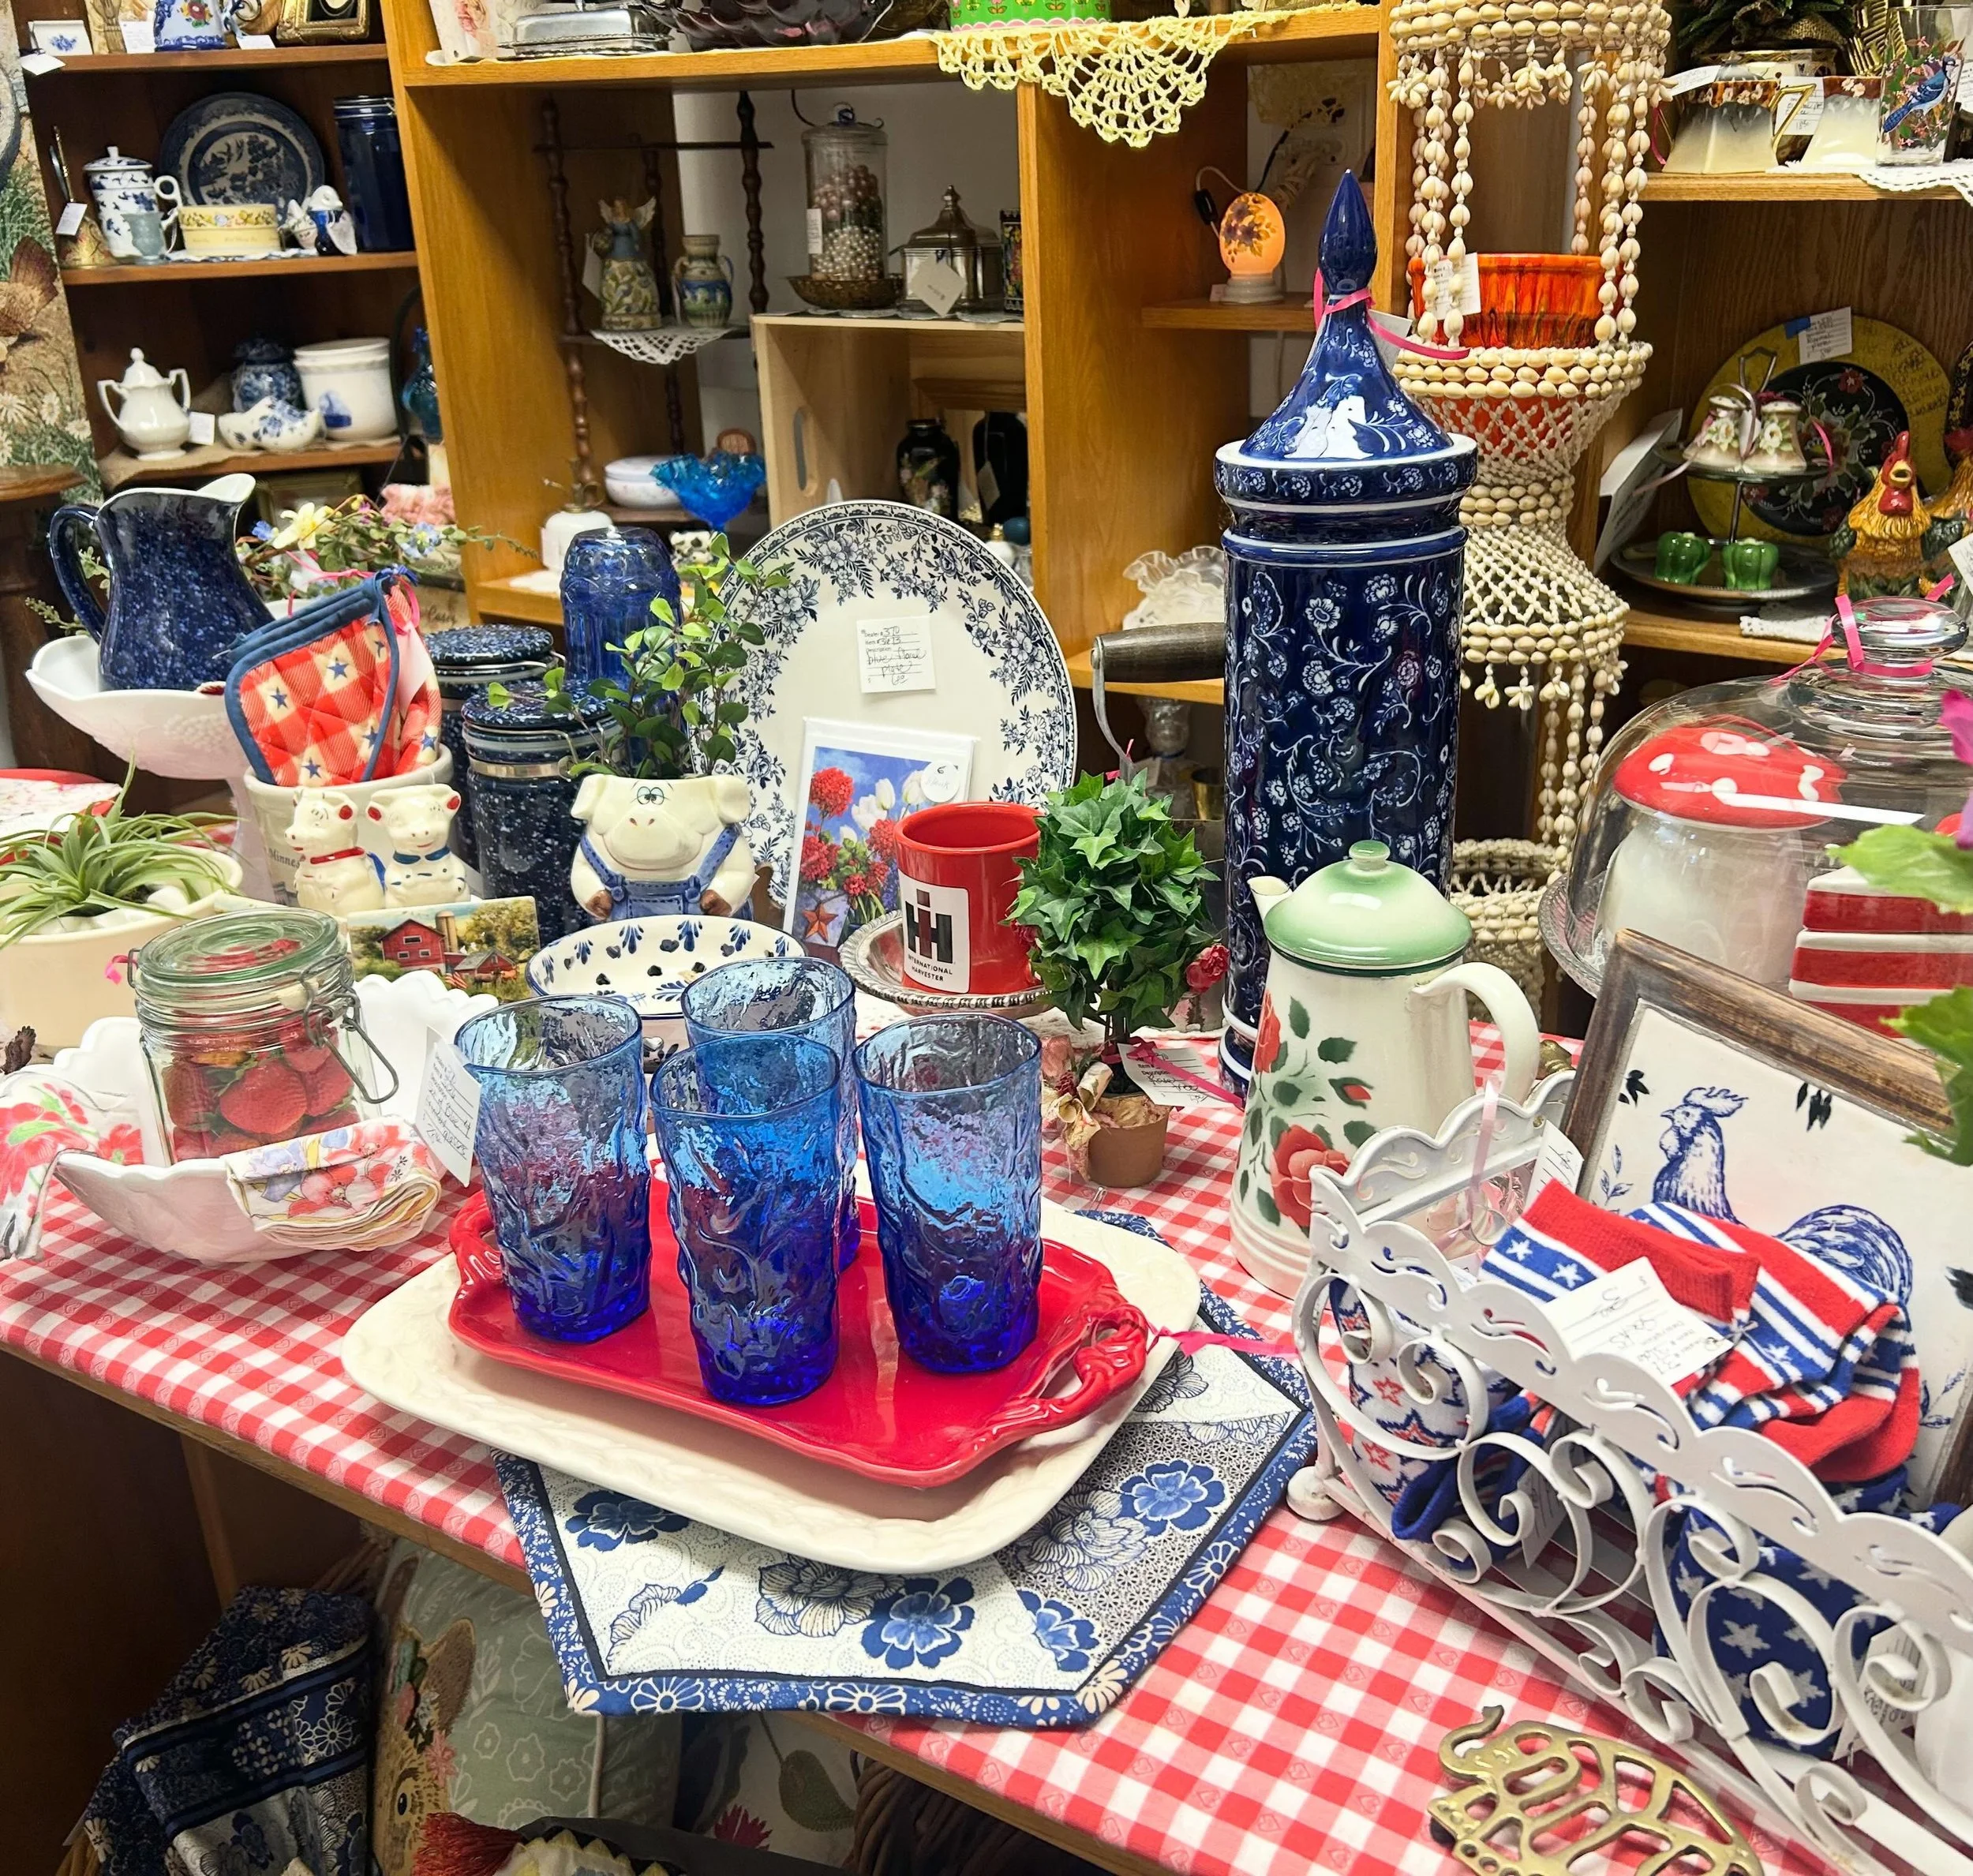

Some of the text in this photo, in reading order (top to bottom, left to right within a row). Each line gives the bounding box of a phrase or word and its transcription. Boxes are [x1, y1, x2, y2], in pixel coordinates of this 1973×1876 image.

[882, 661, 912, 677] plate
[908, 954, 953, 975] INTERNATIONAL
[912, 966, 944, 981] HARVESTER
